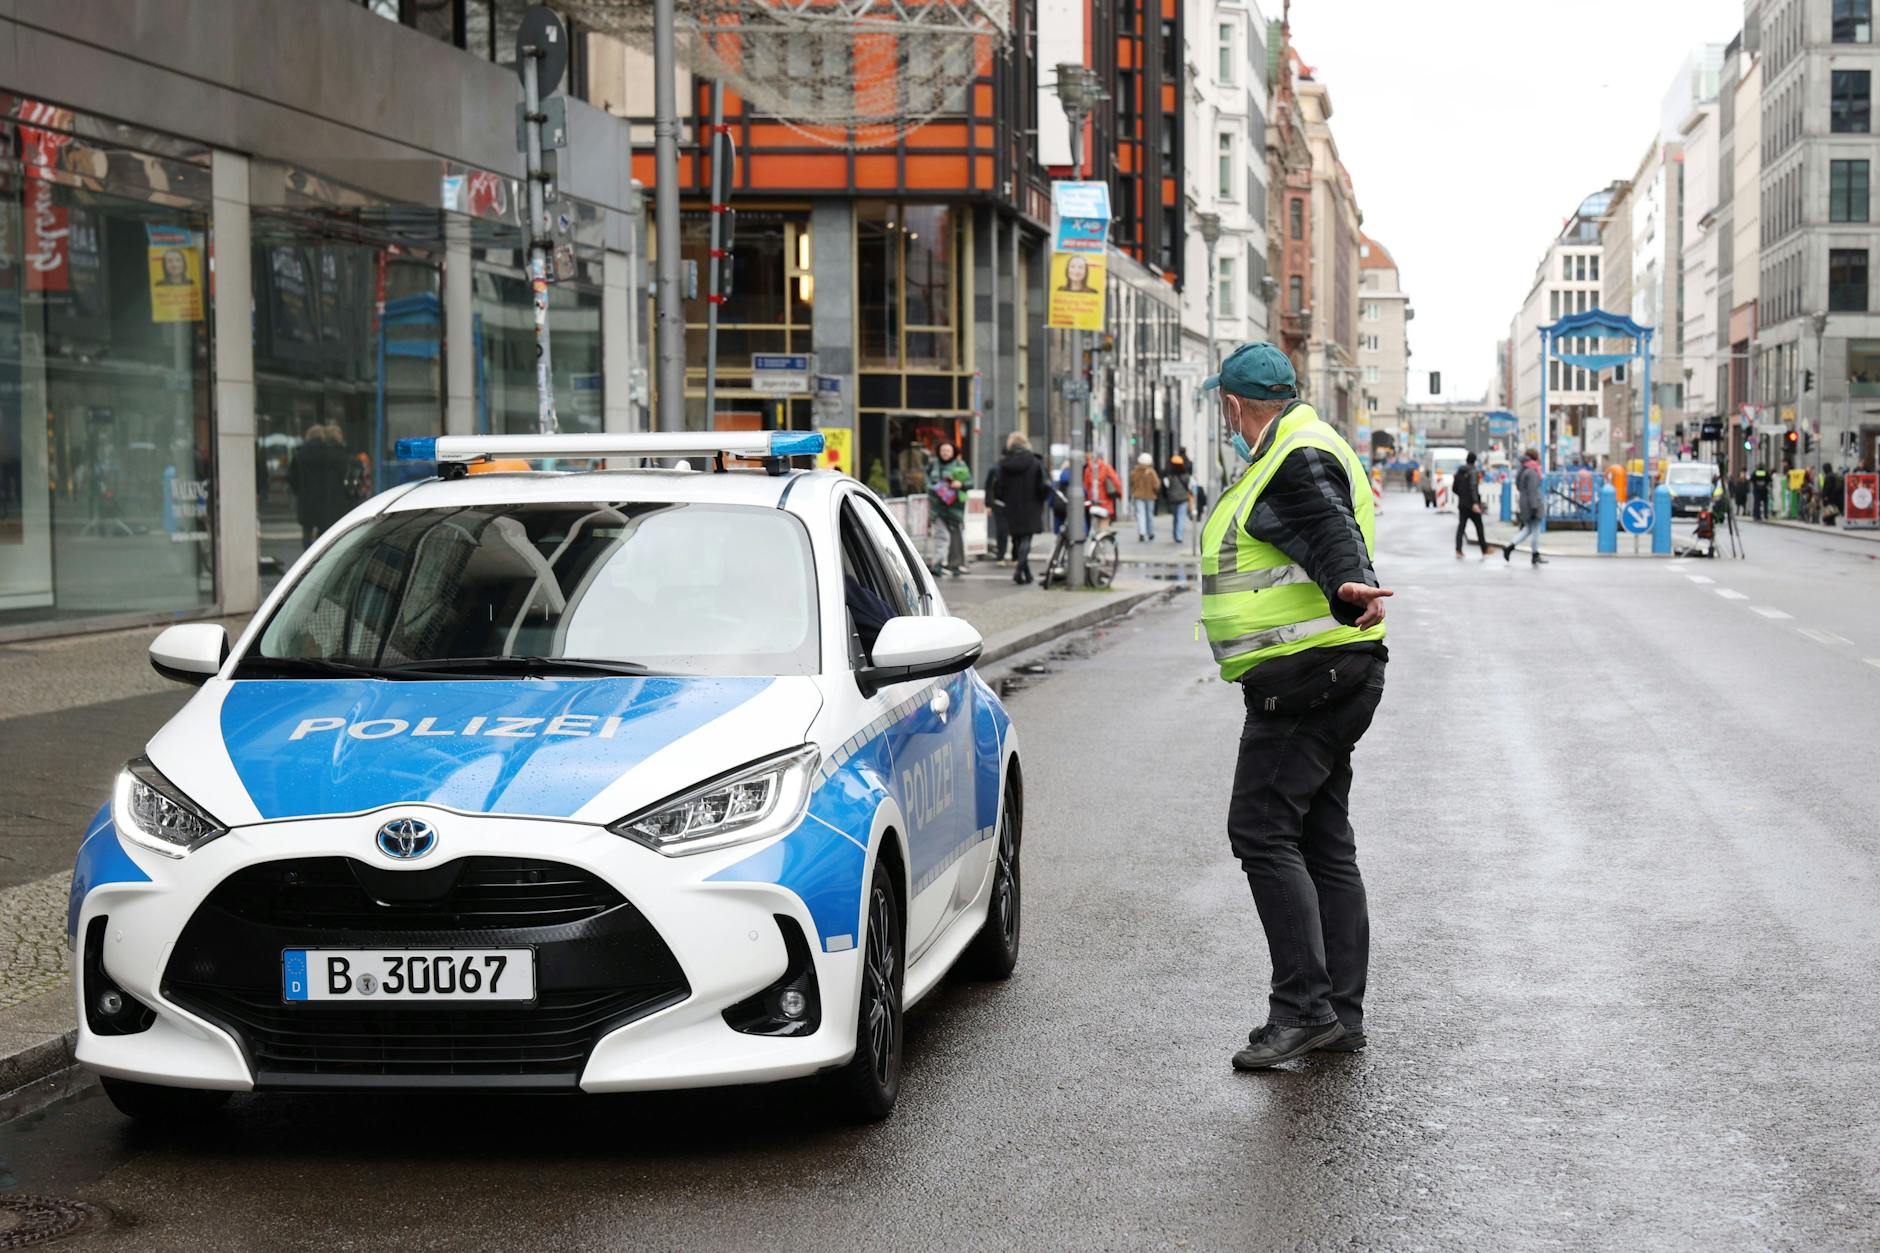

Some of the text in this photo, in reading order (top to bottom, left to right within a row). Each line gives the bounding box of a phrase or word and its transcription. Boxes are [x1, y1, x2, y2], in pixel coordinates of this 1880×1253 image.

[288, 714, 624, 741] POLIZEI
[902, 741, 954, 839] POLIZEI
[292, 955, 508, 994] D B 30067
